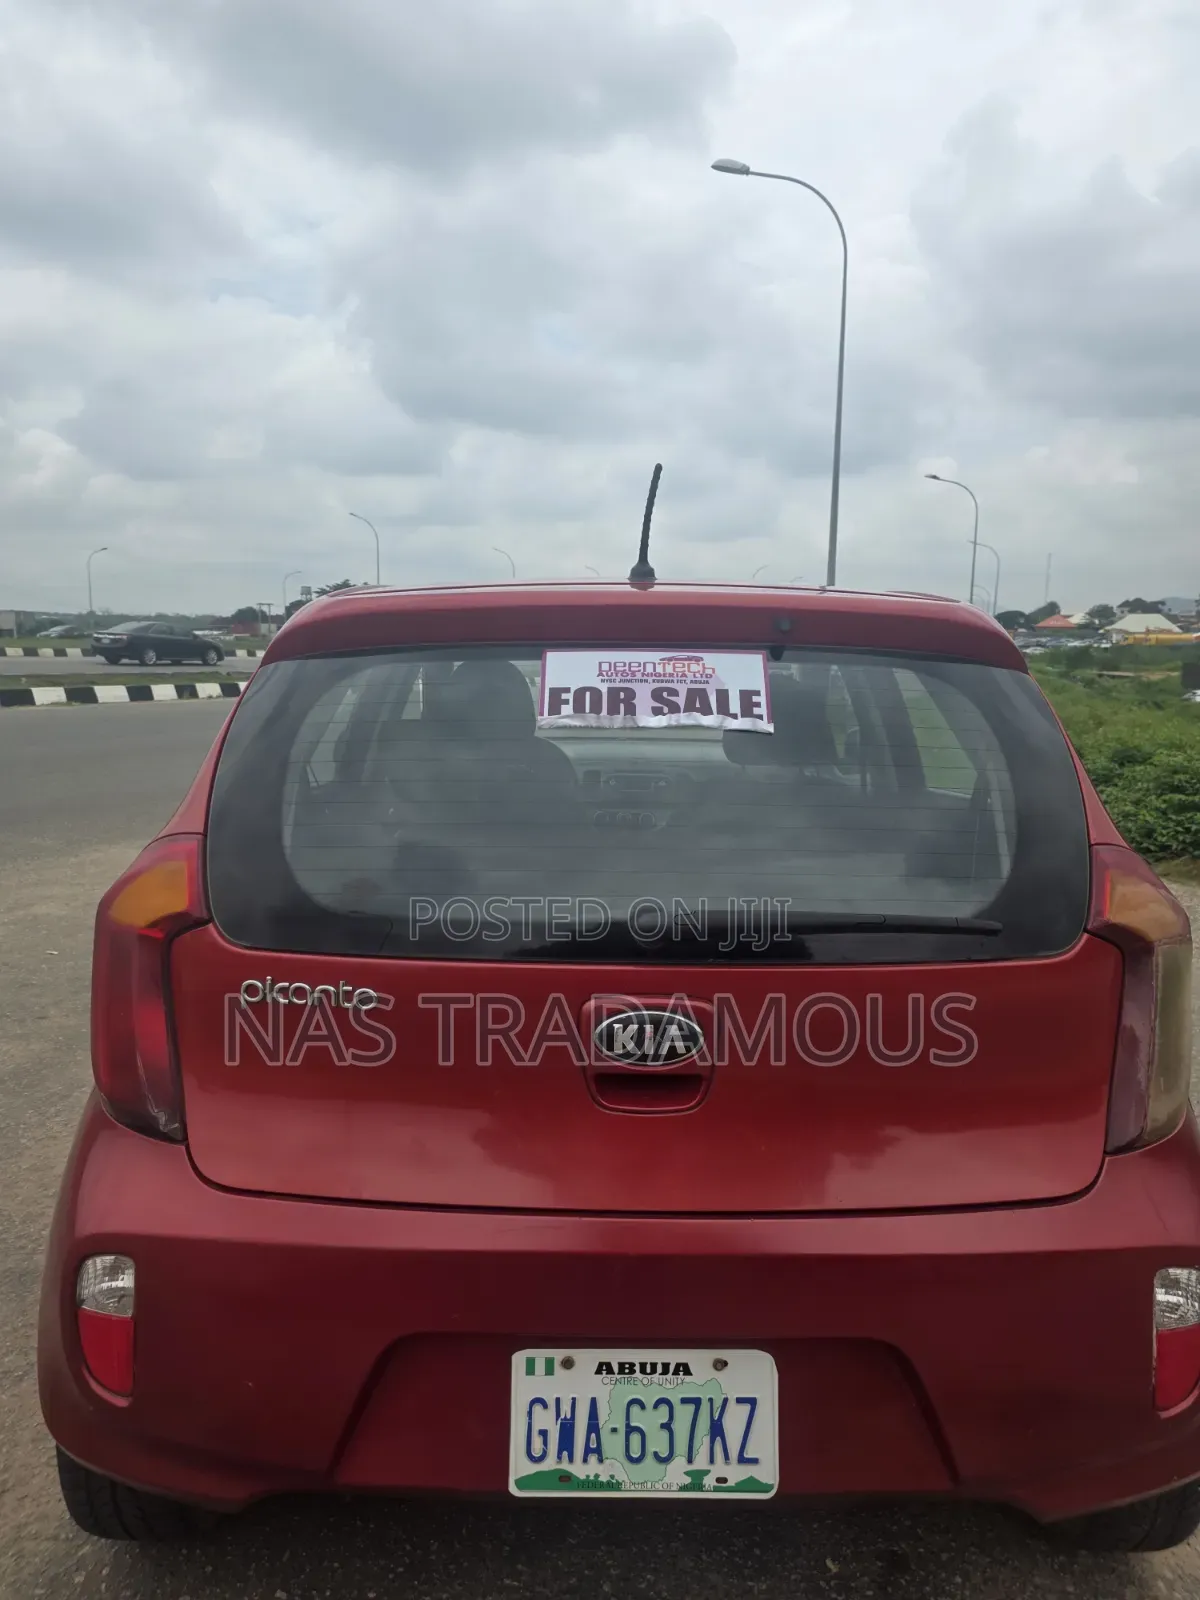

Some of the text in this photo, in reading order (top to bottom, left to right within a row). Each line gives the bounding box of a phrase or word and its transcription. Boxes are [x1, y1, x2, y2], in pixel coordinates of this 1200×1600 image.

[548, 686, 764, 721] FOR SALE
[240, 975, 379, 1010] picanto
[612, 1023, 688, 1055] KIA
[594, 1361, 693, 1376] ABUJA
[601, 1376, 686, 1386] CENTRE OF UNITY
[525, 1397, 760, 1465] GWA-637KZ
[576, 1481, 618, 1489] FEDERAL
[618, 1481, 660, 1490] REPUBLIC
[662, 1482, 674, 1490] OF
